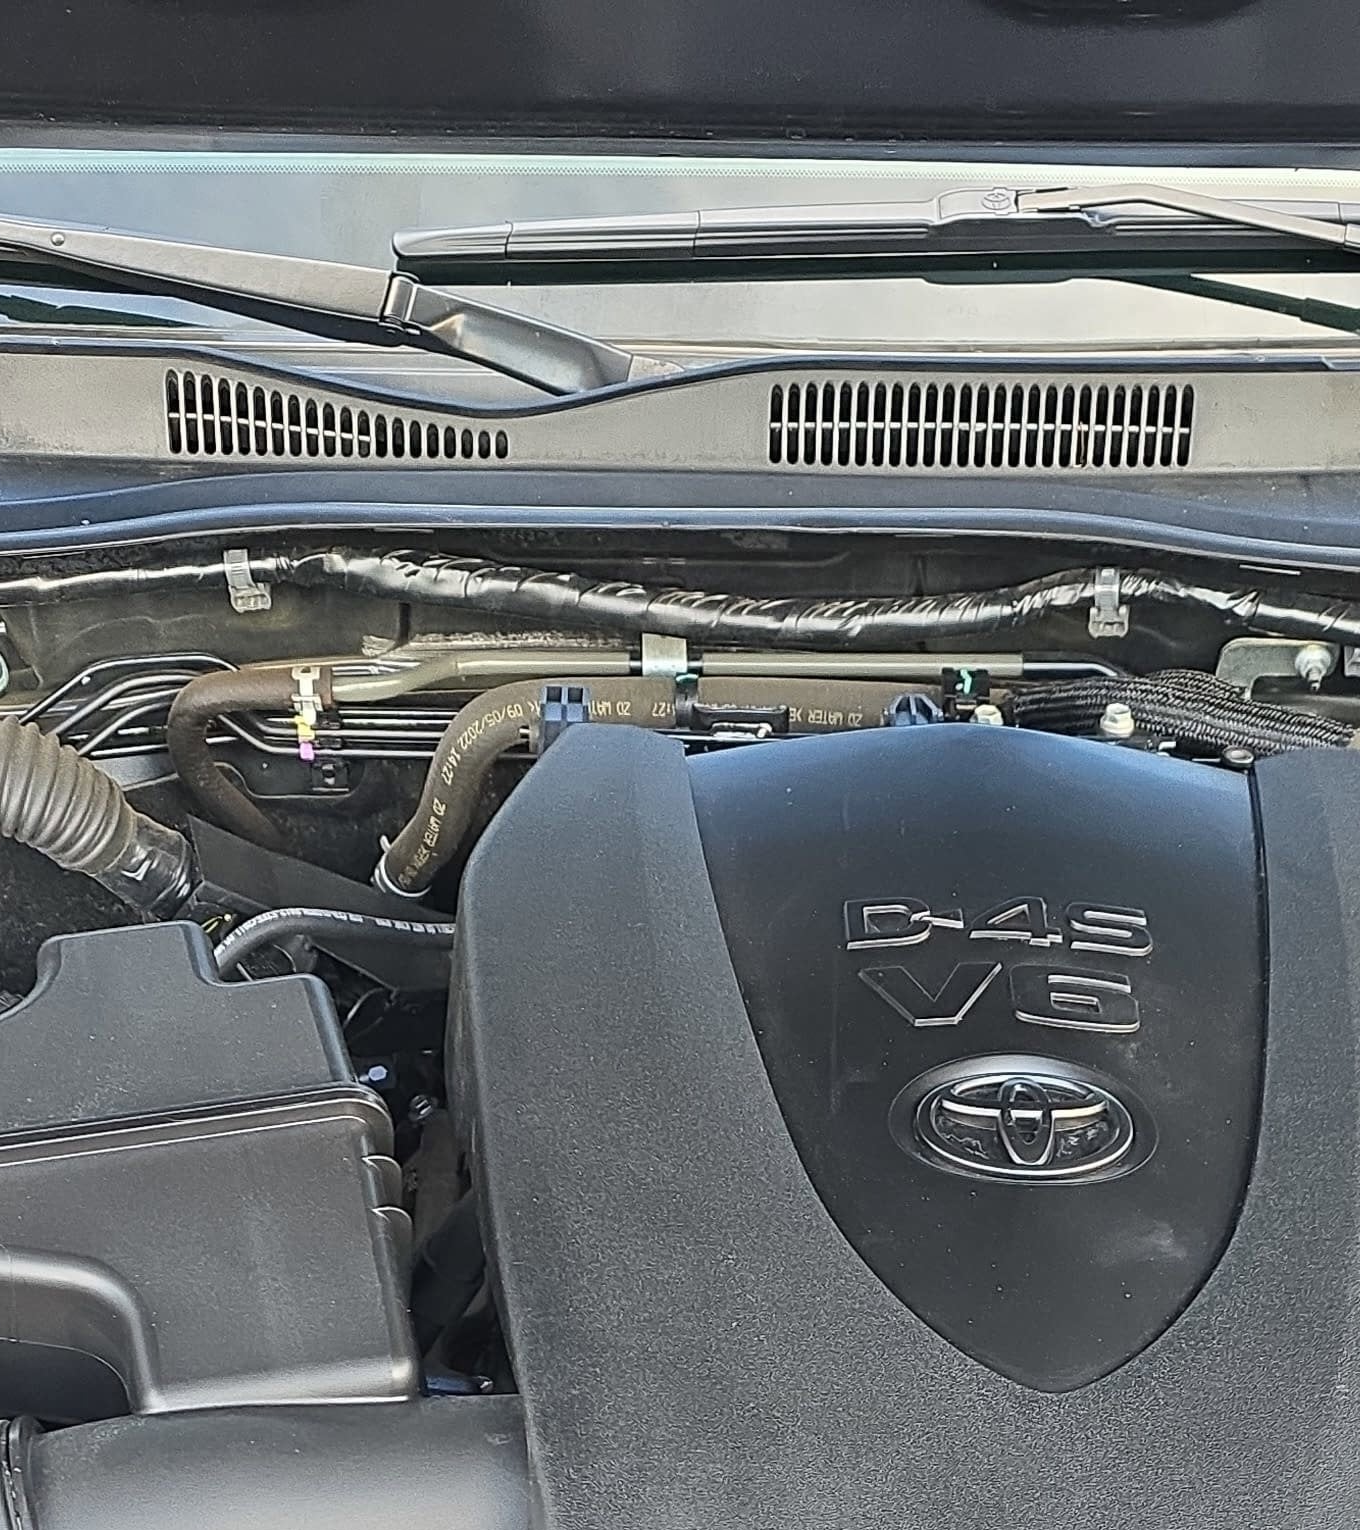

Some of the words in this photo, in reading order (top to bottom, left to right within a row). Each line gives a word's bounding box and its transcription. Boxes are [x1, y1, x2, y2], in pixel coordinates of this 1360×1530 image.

[457, 703, 524, 750] 09/05/2022
[808, 709, 843, 725] WATER
[843, 896, 1153, 957] D-4S
[857, 960, 1140, 1034] V6
